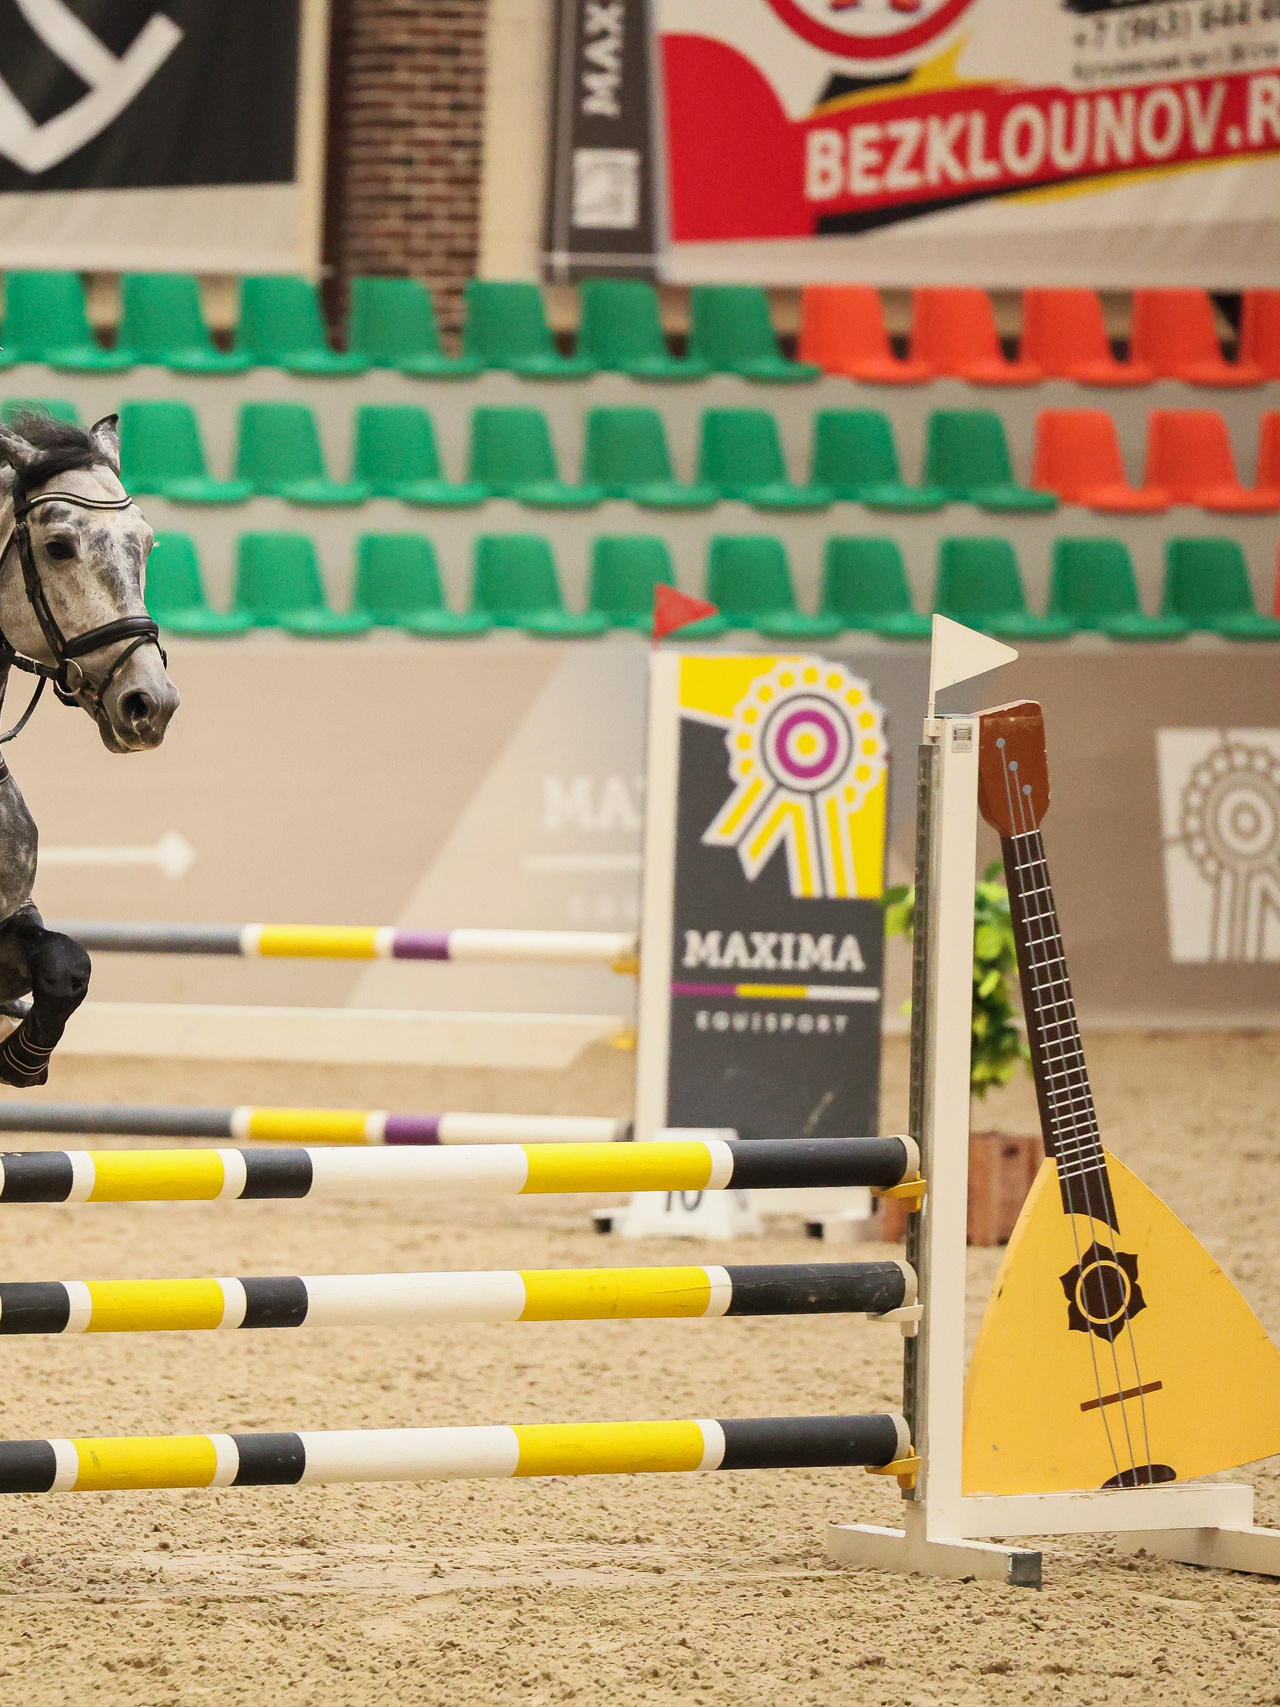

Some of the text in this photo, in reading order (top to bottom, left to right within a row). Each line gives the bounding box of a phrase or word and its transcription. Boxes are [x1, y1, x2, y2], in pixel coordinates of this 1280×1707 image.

[804, 76, 1280, 201] BEZKLOUNOV.R
[541, 773, 643, 830] MA
[682, 928, 866, 973] MAXIMA
[695, 1009, 849, 1035] EQUISPORT
